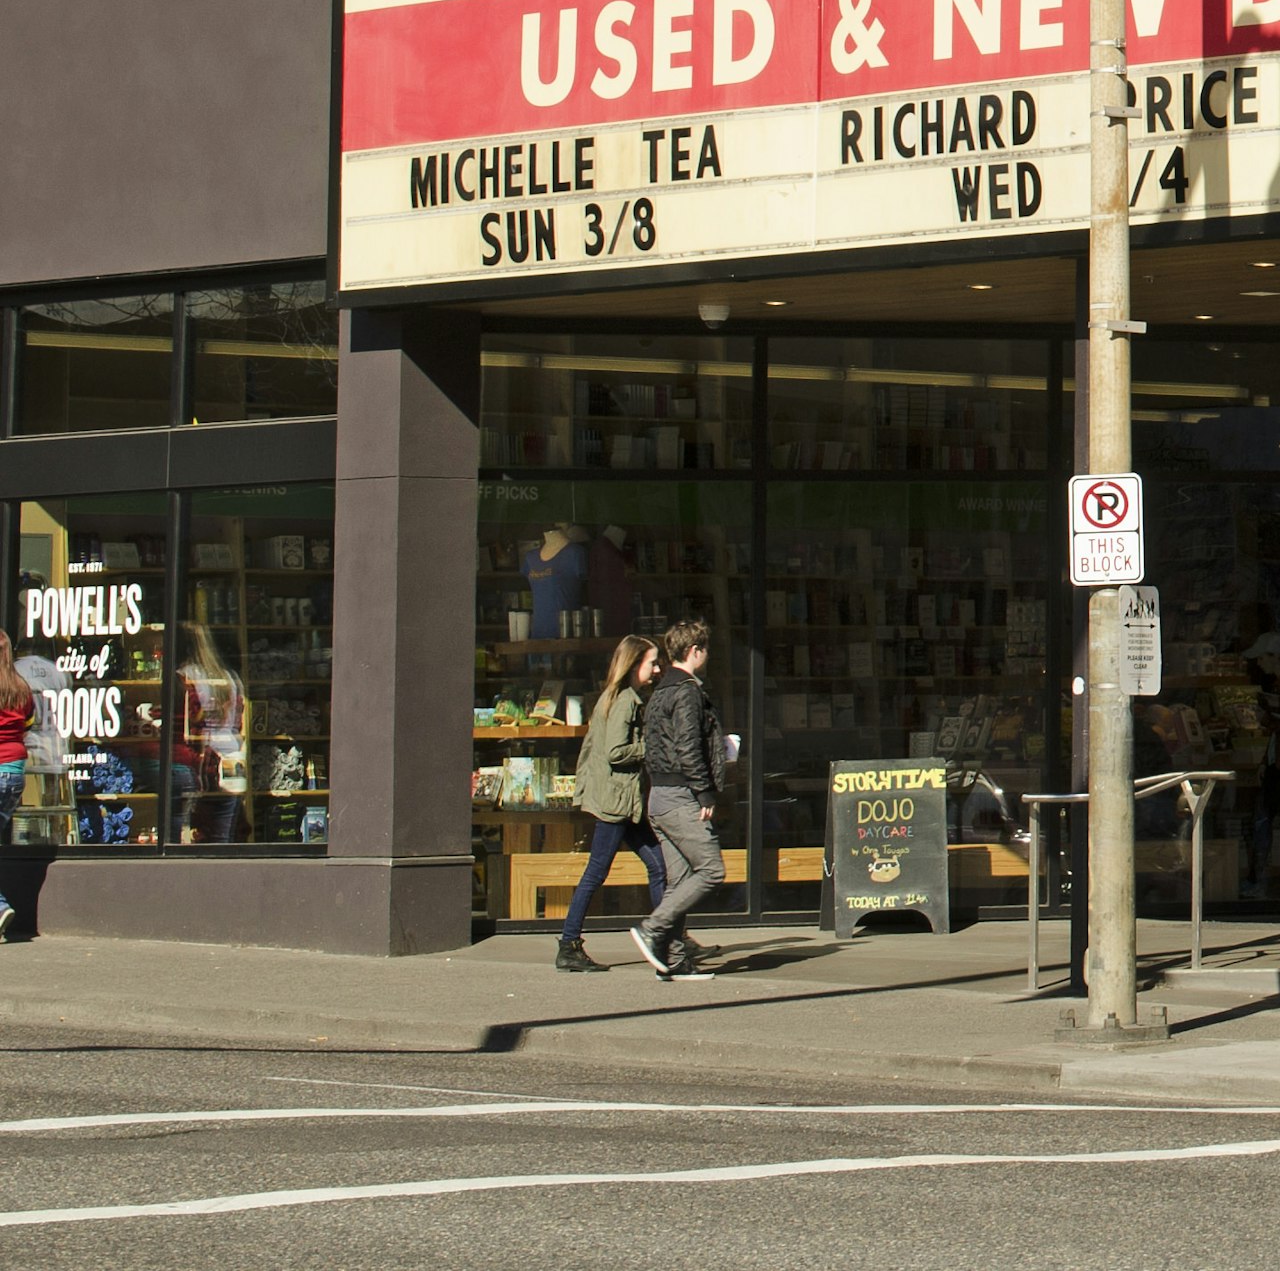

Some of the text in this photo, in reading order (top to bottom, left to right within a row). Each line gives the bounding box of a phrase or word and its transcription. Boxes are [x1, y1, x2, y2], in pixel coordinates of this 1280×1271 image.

[841, 66, 1260, 164] RICHARD RICE
[411, 124, 723, 208] MICHELLE TEA
[952, 146, 1190, 223] WED /4
[481, 197, 657, 266] SUN 3/8
[496, 485, 539, 501] PICKS
[957, 496, 1048, 513] AWARD WINNE
[1088, 537, 1125, 555] THIS
[1081, 554, 1133, 574] BLOCK
[26, 583, 143, 638] POWELL'S
[56, 646, 89, 678] city
[90, 644, 110, 679] of
[832, 768, 947, 794] STORYTIME
[857, 798, 915, 824] DOJO
[858, 825, 915, 839] DAYCARE
[846, 896, 880, 909] TODAY
[882, 895, 899, 908] AT
